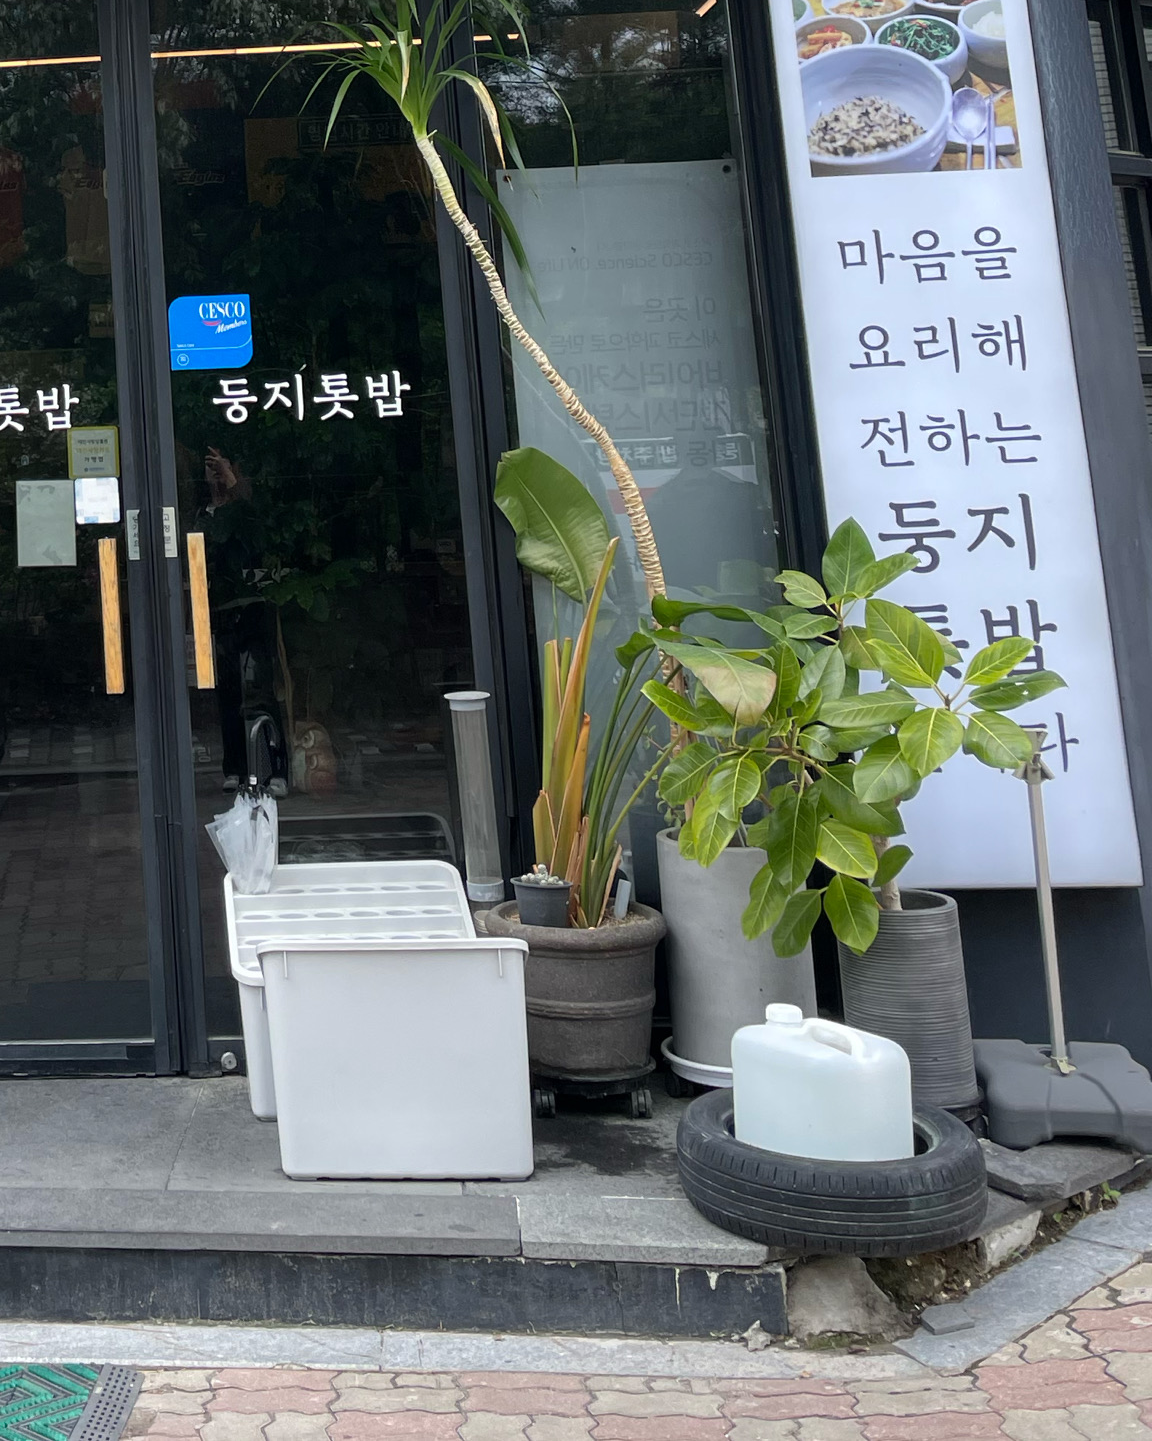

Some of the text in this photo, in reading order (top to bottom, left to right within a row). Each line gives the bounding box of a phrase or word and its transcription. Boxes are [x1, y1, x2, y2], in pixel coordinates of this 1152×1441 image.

[836, 226, 1018, 285] 마음을
[199, 300, 246, 320] CESCO
[214, 318, 248, 334] Members
[849, 314, 1028, 374] 요리해
[211, 369, 412, 425] 둥지톳밥
[860, 409, 1042, 467] 전하는
[878, 493, 1036, 574] 둥지
